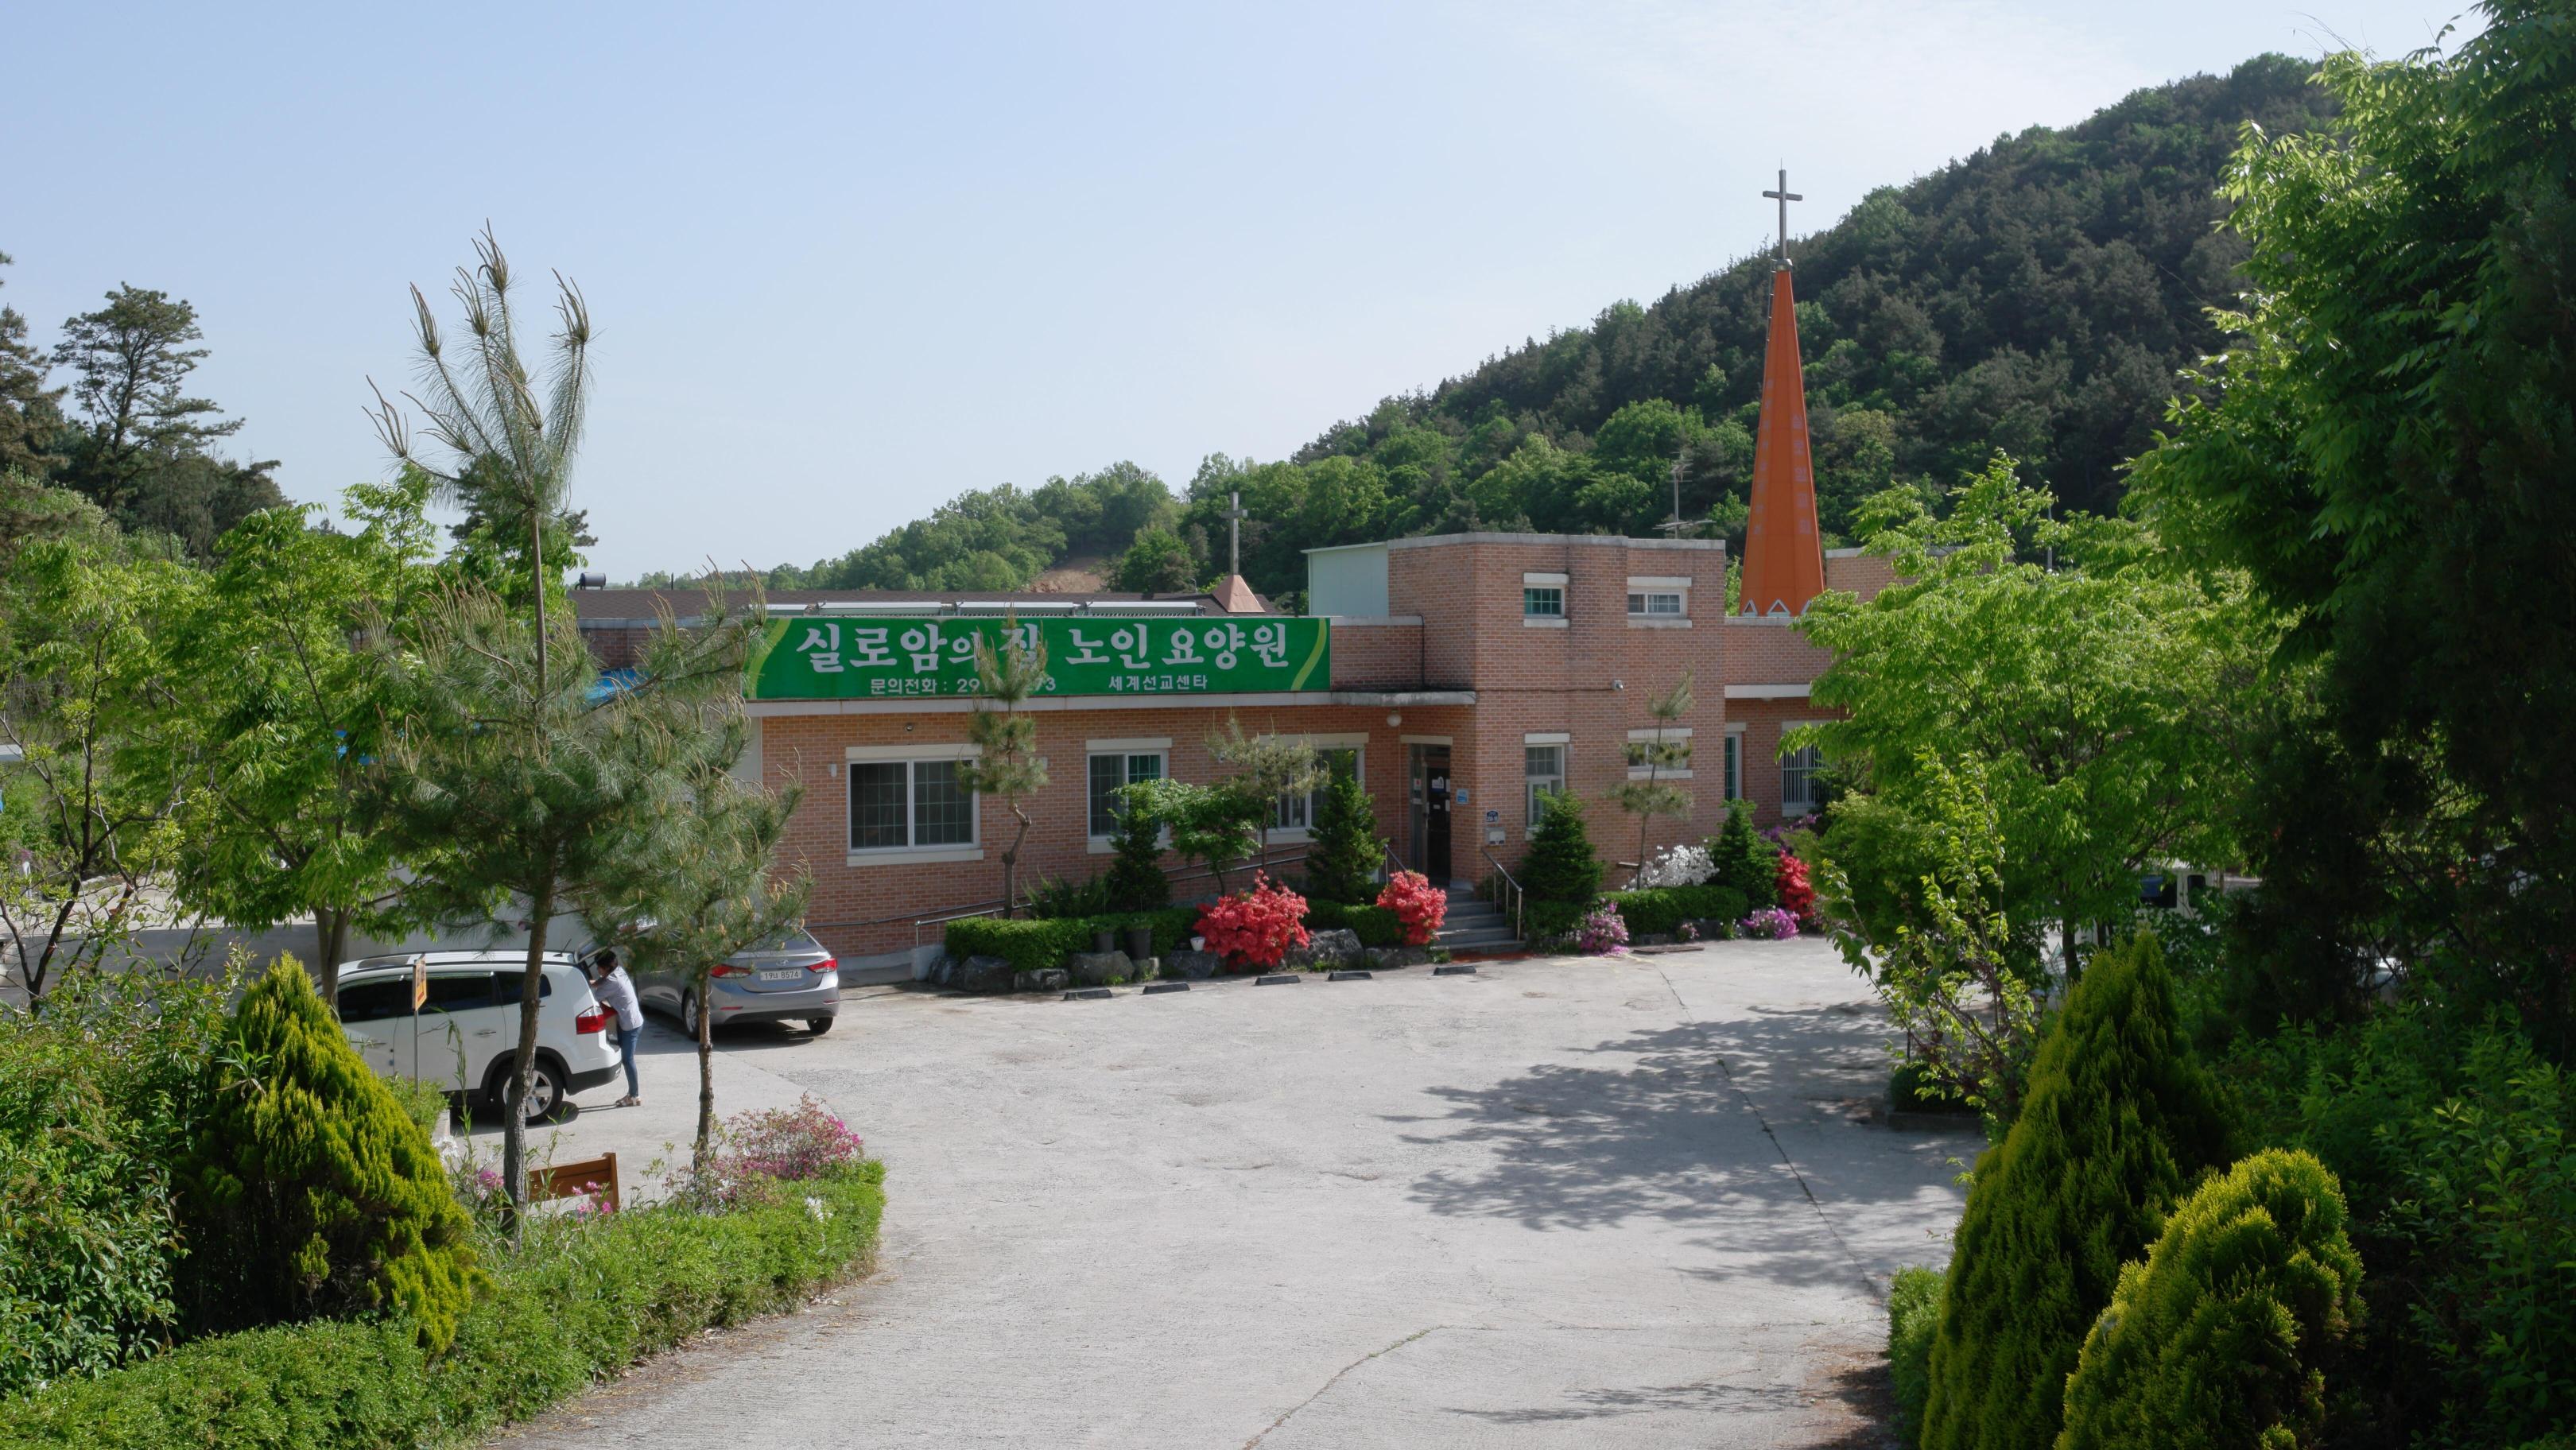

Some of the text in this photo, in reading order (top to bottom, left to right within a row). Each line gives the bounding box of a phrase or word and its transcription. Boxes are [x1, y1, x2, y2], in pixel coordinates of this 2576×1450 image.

[796, 623, 980, 674] 실로암의
[1065, 623, 1151, 669] 노인
[1162, 623, 1289, 669] 요양원
[1109, 674, 1208, 691] 세계선교센타
